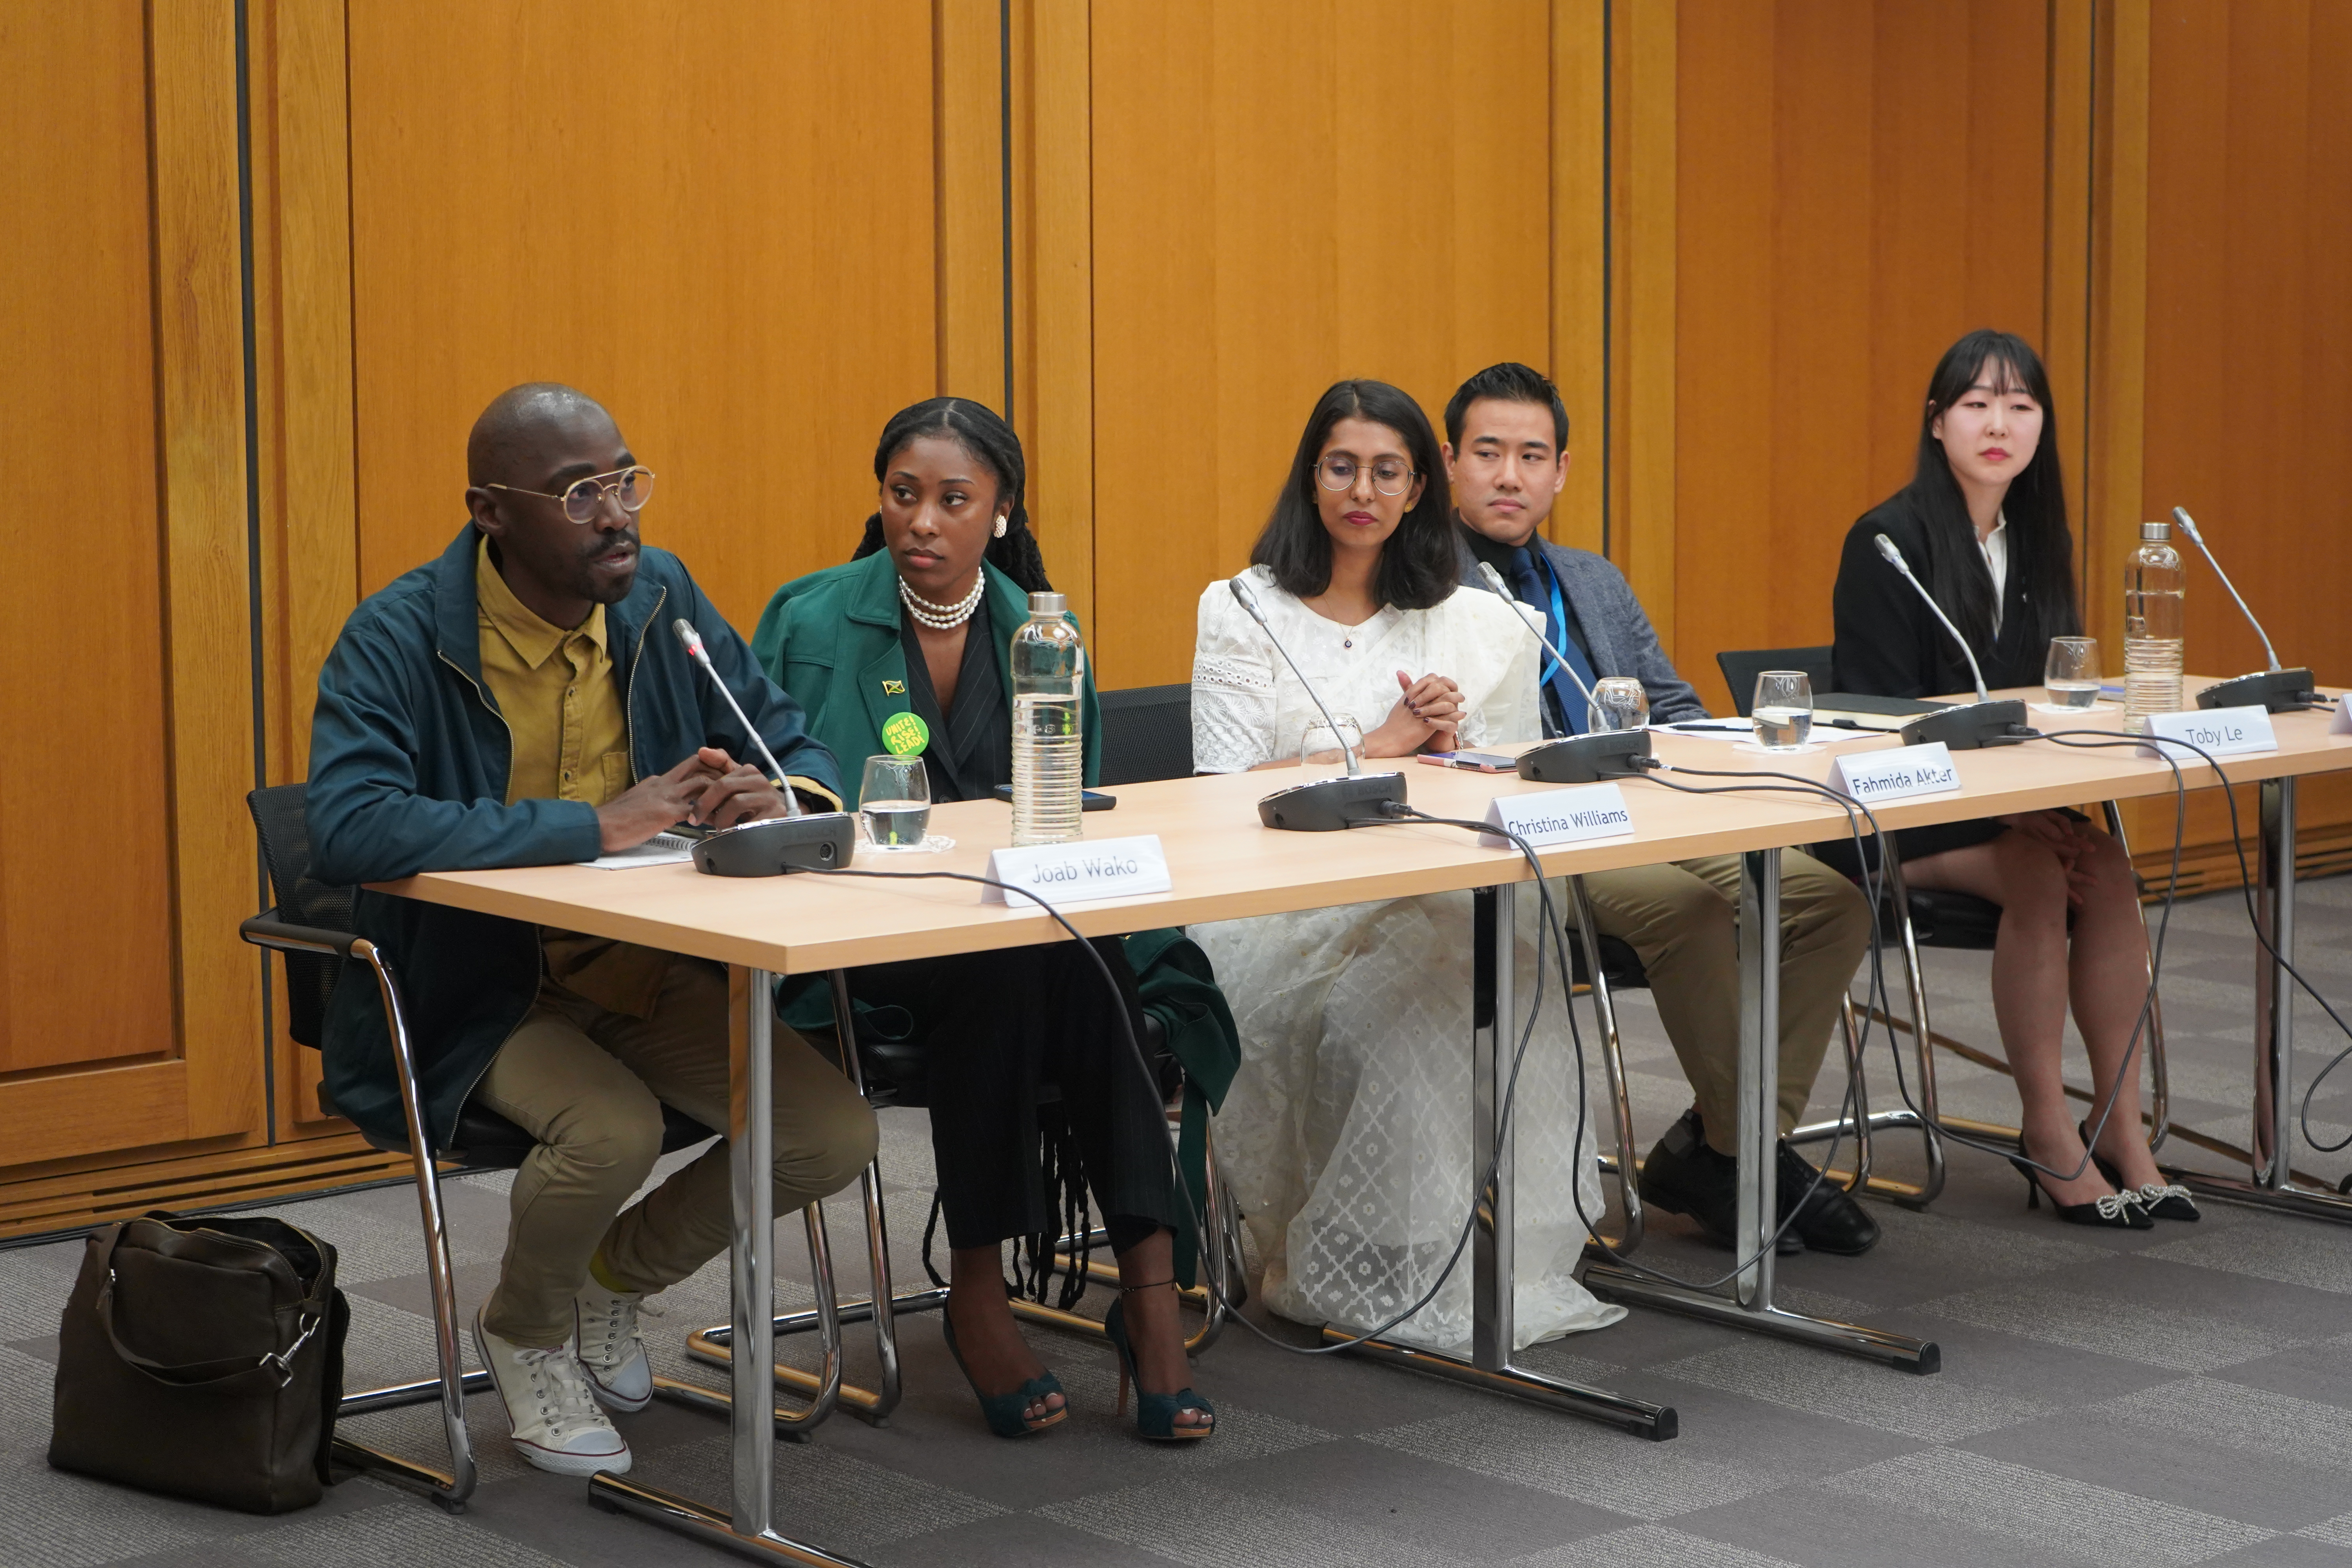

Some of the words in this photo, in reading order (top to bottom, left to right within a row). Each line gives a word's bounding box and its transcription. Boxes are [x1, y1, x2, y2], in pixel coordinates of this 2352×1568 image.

[886, 715, 916, 736] UNITE!
[891, 726, 920, 745] RISE!
[895, 735, 925, 754] LEAD!
[2185, 728, 2220, 746] Toby
[2225, 726, 2242, 741] Le
[1358, 782, 1392, 795] BOSCH
[1853, 772, 1913, 795] Fahmida
[1916, 768, 1952, 786] Akter
[1509, 817, 1569, 836] Christina
[1570, 810, 1628, 828] Williams
[1033, 861, 1077, 883] Joab
[1083, 856, 1138, 878] Wako
